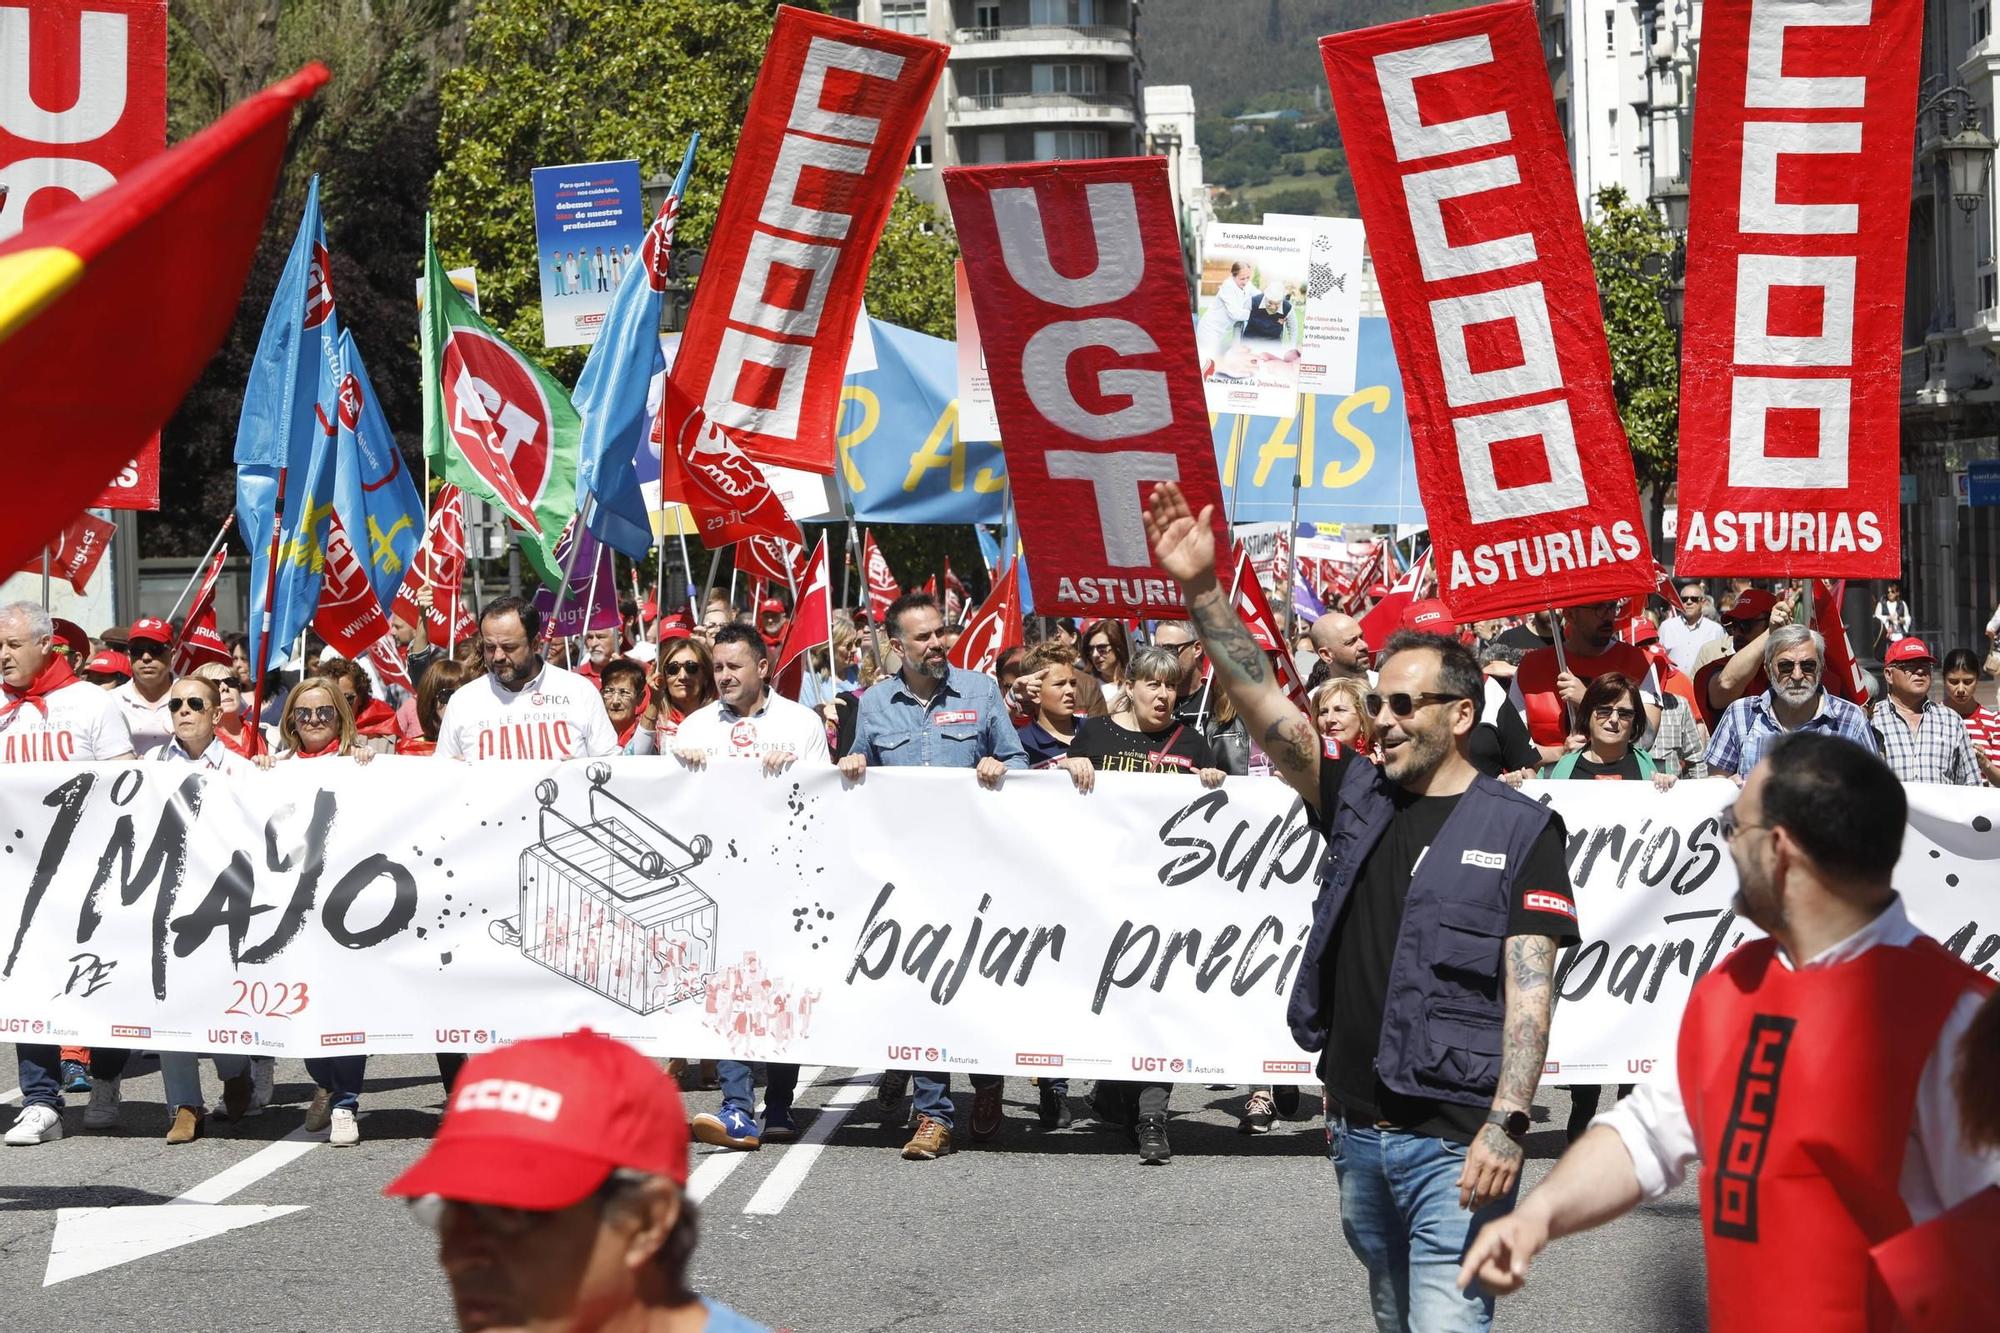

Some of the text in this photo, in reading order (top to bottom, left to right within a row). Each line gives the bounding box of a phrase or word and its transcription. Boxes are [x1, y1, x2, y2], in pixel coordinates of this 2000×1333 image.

[556, 202, 592, 210] debemos
[587, 208, 623, 218] nuestros
[562, 219, 617, 232] profesionales
[703, 36, 907, 440] CCOO
[1727, 0, 1873, 489] CCOO
[1373, 33, 1589, 525] CCOO
[989, 182, 1180, 568] UGT
[1684, 511, 1883, 553] ASTURIAS
[1448, 520, 1642, 591] ASTURIAS
[1057, 576, 1187, 606] ASTURI
[1414, 611, 1441, 624] CCOO
[30, 721, 72, 730] PONES
[524, 711, 568, 722] PONES
[753, 742, 796, 752] PONES
[1465, 852, 1502, 867] CCOO
[1526, 894, 1569, 912] CCOO
[845, 882, 1067, 1007] bajar
[224, 980, 311, 1021] 2023
[112, 1026, 140, 1037] CCOO
[208, 1029, 238, 1044] UGT
[261, 1038, 286, 1049] Asturias
[322, 1035, 352, 1044] CCOO
[435, 1028, 471, 1044] UGT
[888, 1045, 979, 1065] UGT Asturias
[1016, 1054, 1050, 1065] CCOO
[1131, 1056, 1225, 1074] UGT Asturias
[1264, 1062, 1297, 1072] CCOO
[454, 1078, 563, 1123] CCOO
[1719, 1026, 1786, 1228] CCOO
